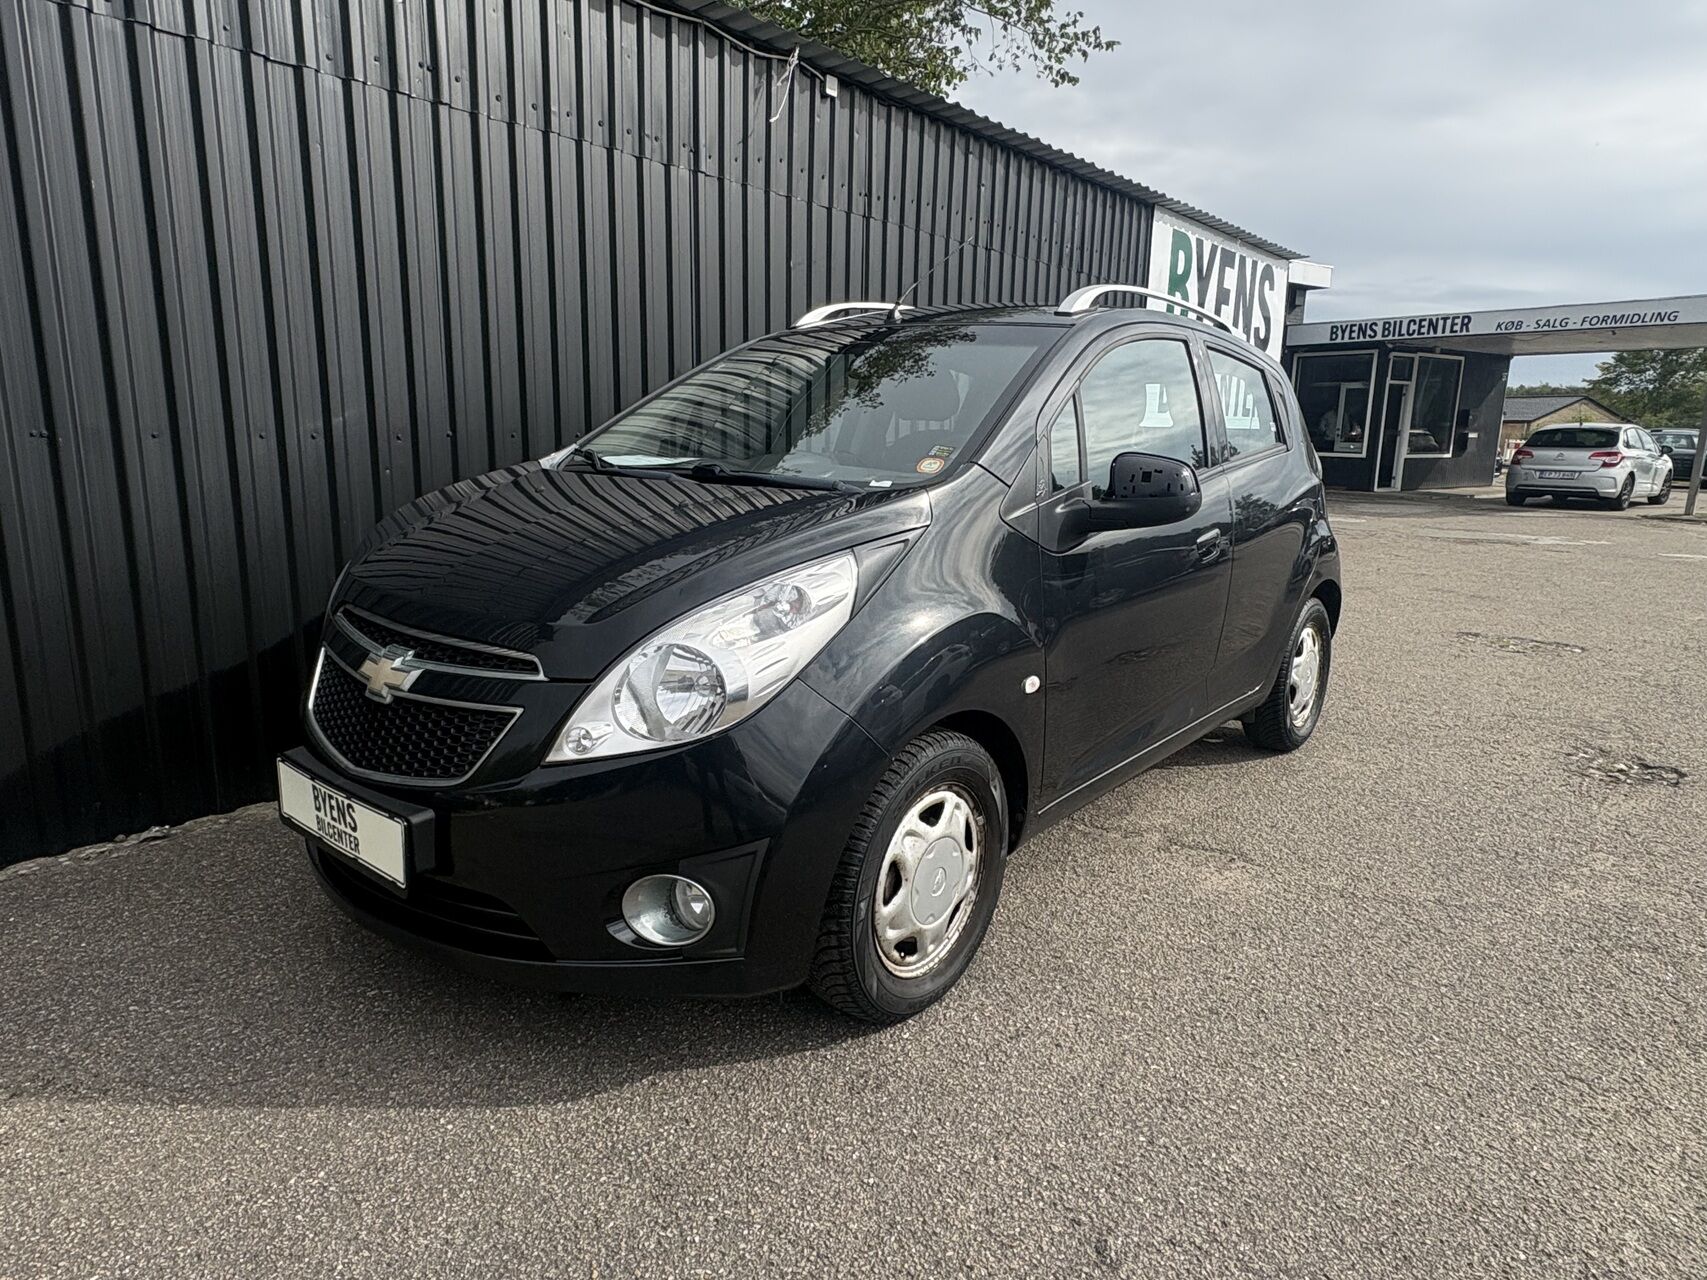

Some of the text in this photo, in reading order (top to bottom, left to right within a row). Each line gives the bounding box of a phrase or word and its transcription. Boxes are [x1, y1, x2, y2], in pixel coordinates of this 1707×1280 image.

[1329, 314, 1472, 342] BYENS BILCENTER
[1495, 319, 1523, 332] KØB
[1533, 317, 1571, 330] SALG
[1580, 310, 1680, 327] FORMIDLING
[311, 784, 358, 833] BYENS
[316, 814, 361, 855] BILCENTER
